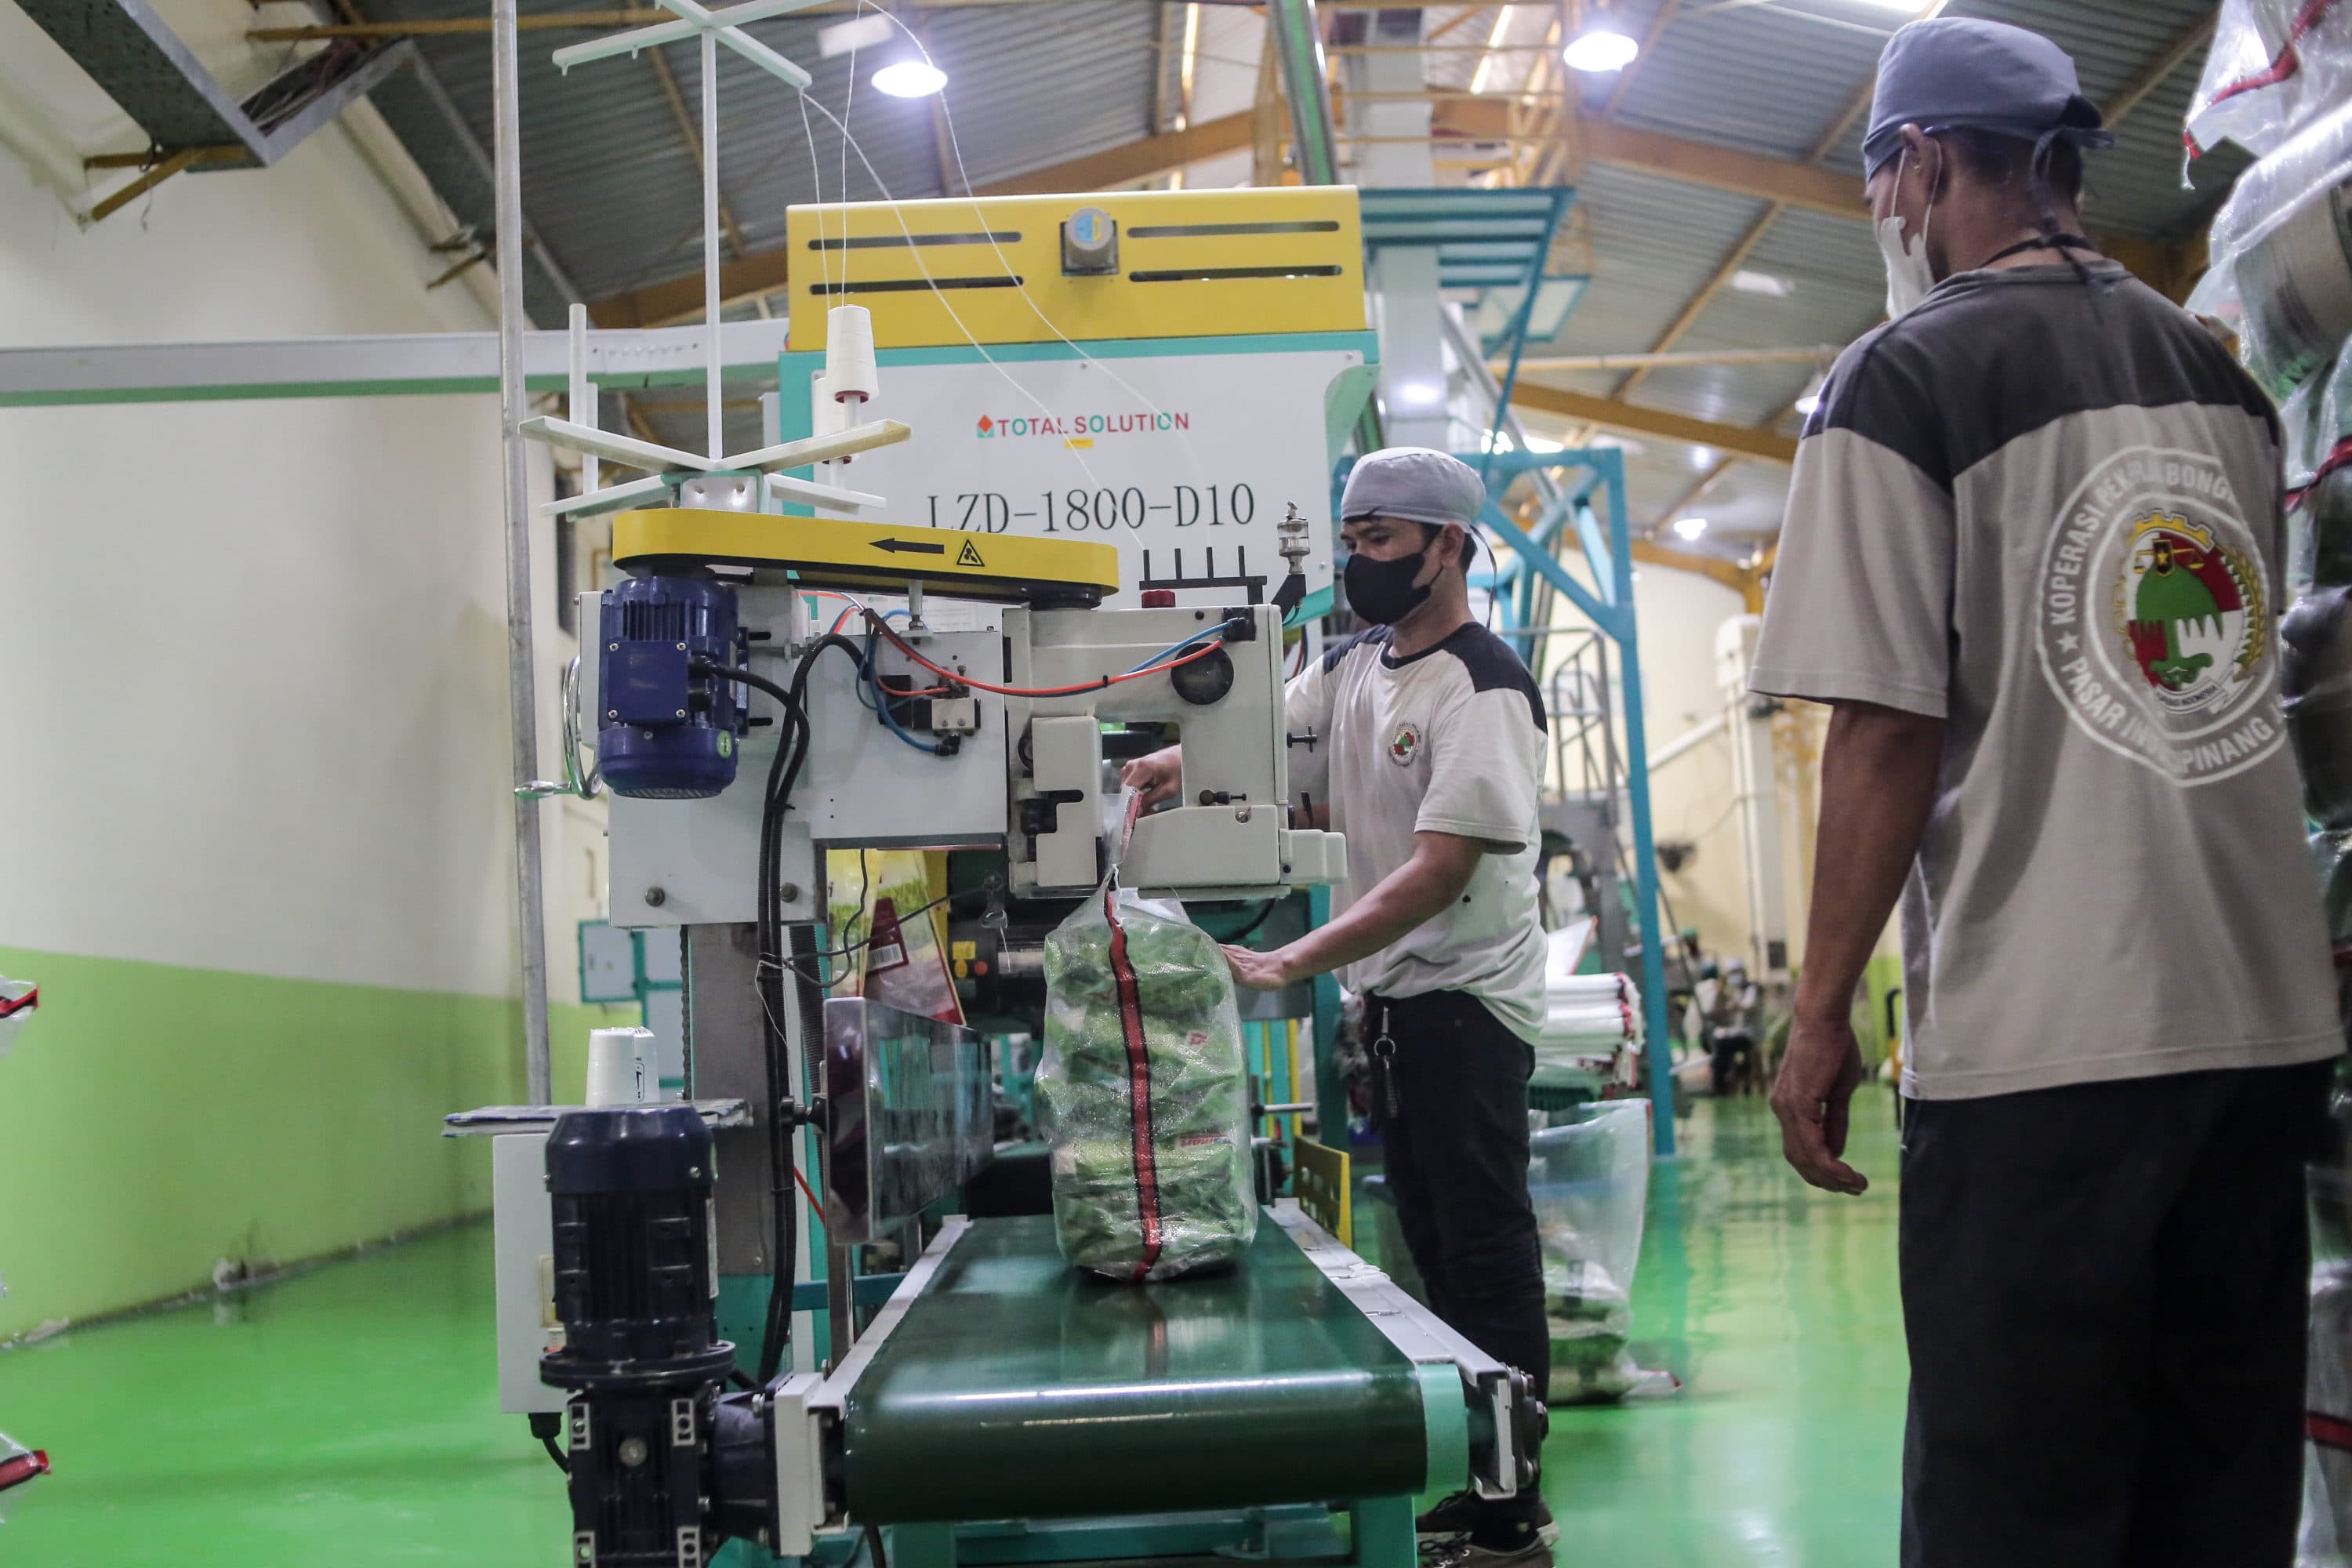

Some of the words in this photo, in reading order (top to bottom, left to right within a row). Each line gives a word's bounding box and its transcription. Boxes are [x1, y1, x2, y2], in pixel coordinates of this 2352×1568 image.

[997, 416, 1069, 437] TOTAL
[1075, 412, 1189, 434] SOLUTION
[928, 483, 1254, 534] LZD-1800-D10
[2048, 503, 2105, 626] KOPERASI
[2060, 655, 2126, 730] PASAR
